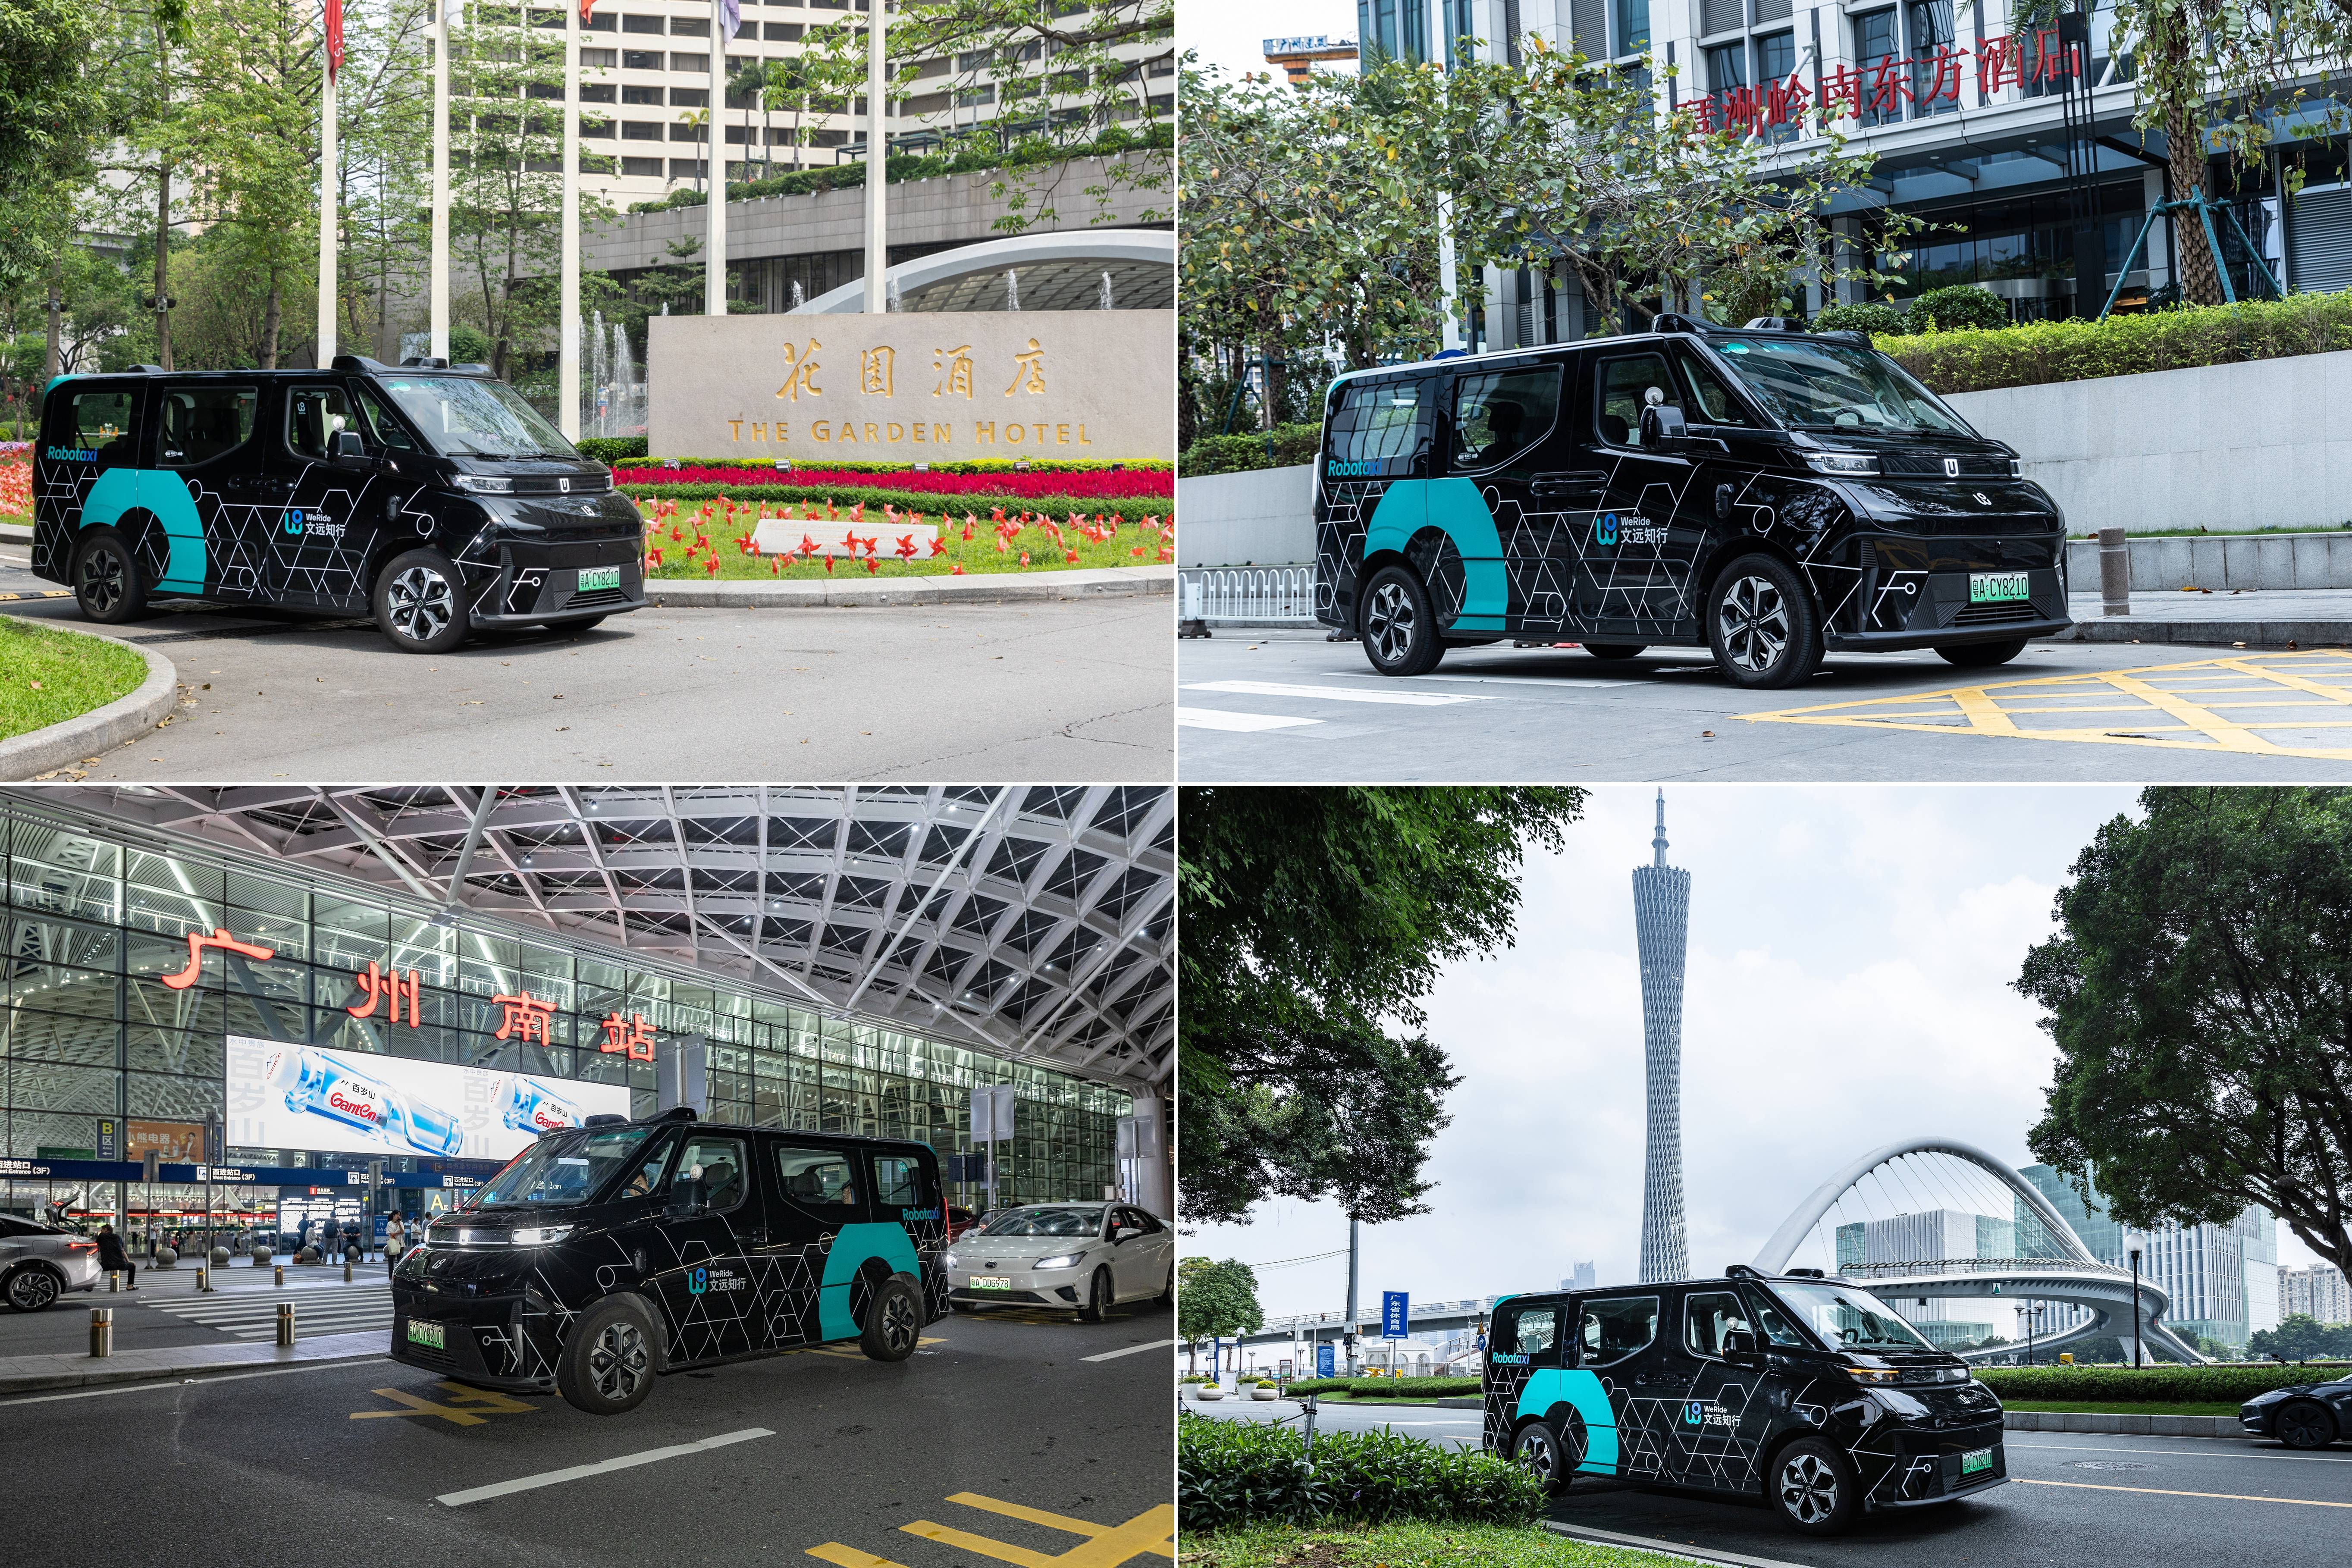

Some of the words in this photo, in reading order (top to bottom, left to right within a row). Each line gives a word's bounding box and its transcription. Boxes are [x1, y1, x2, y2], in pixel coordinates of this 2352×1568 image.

[775, 337, 1045, 402] 花园酒店
[728, 420, 789, 443] THE
[811, 420, 952, 443] GARDEN
[975, 421, 1092, 445] HOTEL
[48, 445, 97, 461] Robotaxi
[1328, 457, 1382, 477] Robotaxi
[306, 513, 331, 522] WeRide
[1621, 516, 1651, 526] WeRide
[305, 521, 346, 537] 文远知行
[1620, 527, 1668, 545] 文远知行
[161, 928, 656, 1062] 广州南站
[229, 1038, 265, 1049] 水中贵族
[463, 1069, 489, 1077] 水中贵族
[229, 1047, 266, 1146] 百岁山
[352, 1083, 375, 1099] 百岁山
[551, 1104, 568, 1118] 百岁山
[102, 1123, 113, 1134] B
[103, 1135, 113, 1145] 区
[0, 1161, 31, 1169] 进站口
[33, 1167, 50, 1175] (3F)
[902, 1206, 939, 1221] Robotaxi
[709, 1270, 733, 1278] WeRide
[709, 1277, 746, 1292] 文远知行
[1389, 1295, 1401, 1330] 广东省体育局
[1493, 1352, 1530, 1364] Robotaxi
[1704, 1405, 1727, 1414] WeRide
[1704, 1412, 1741, 1427] 文远知行
